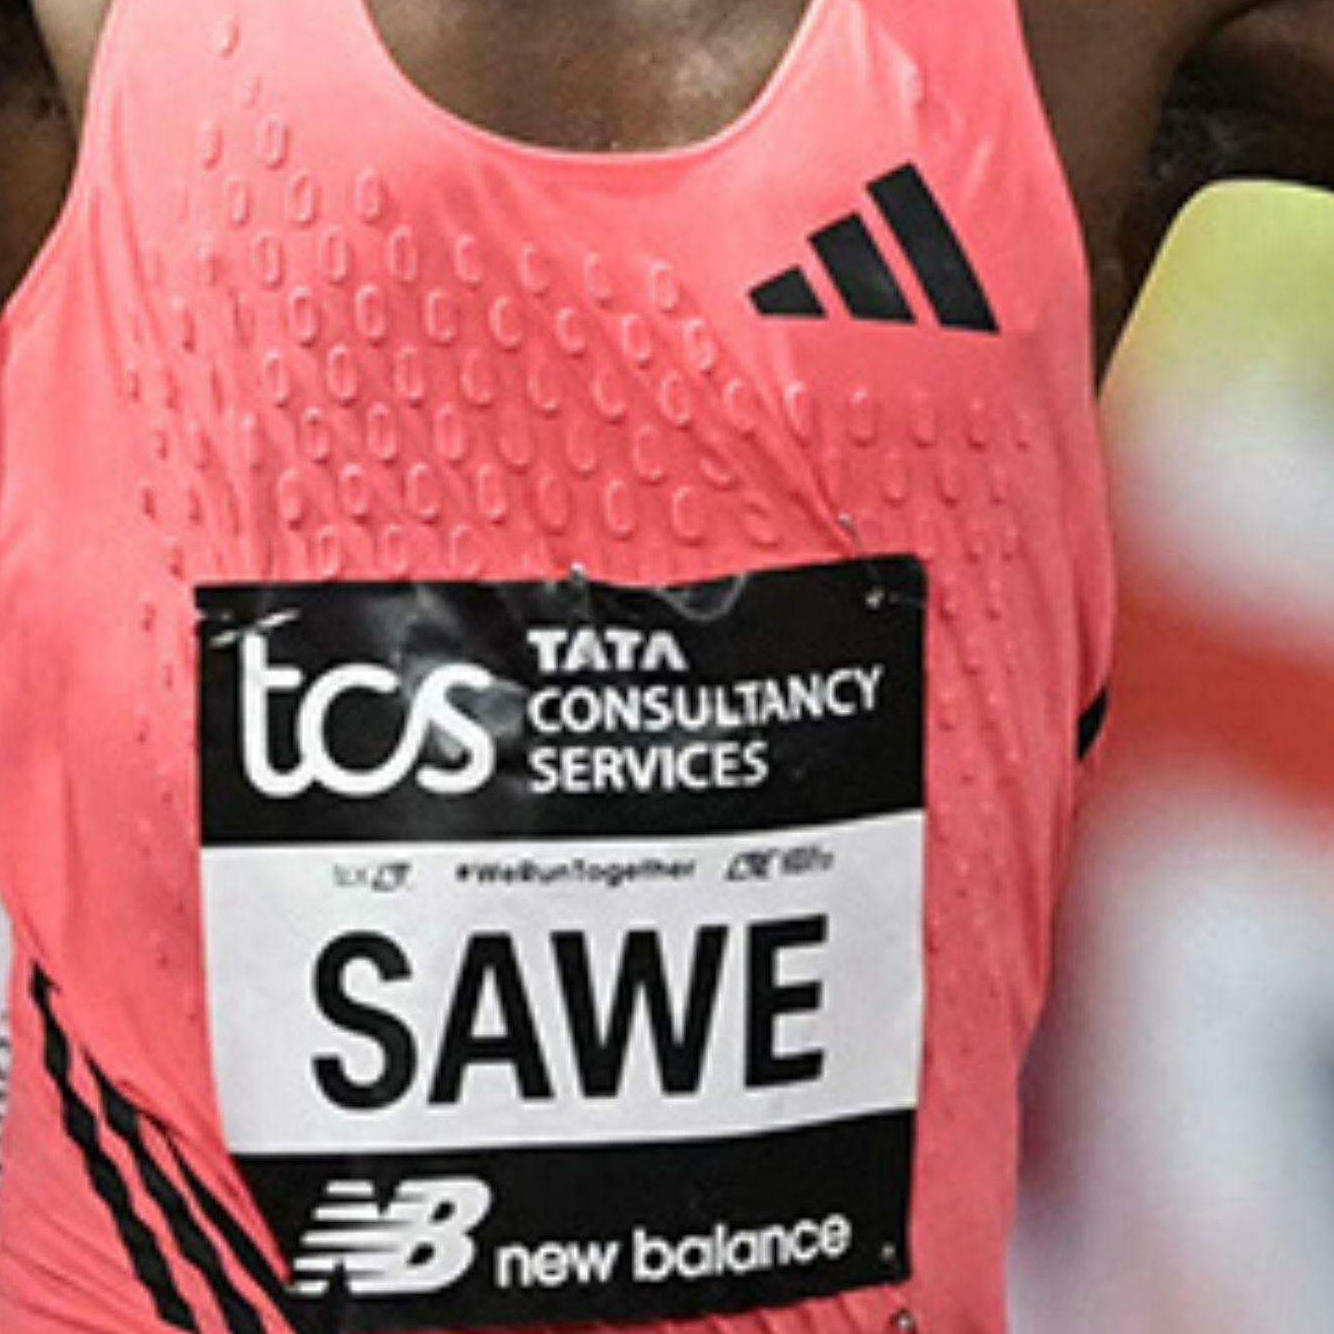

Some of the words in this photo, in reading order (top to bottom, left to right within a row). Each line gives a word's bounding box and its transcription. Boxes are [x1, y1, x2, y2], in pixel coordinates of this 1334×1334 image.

[527, 629, 687, 671] TATA
[240, 631, 496, 798] tcs
[527, 666, 883, 734] CONSULTANCY
[528, 740, 769, 793] SERVICES
[311, 913, 829, 1111] SAWE
[496, 1245, 623, 1288] new
[633, 1214, 853, 1281] balance
